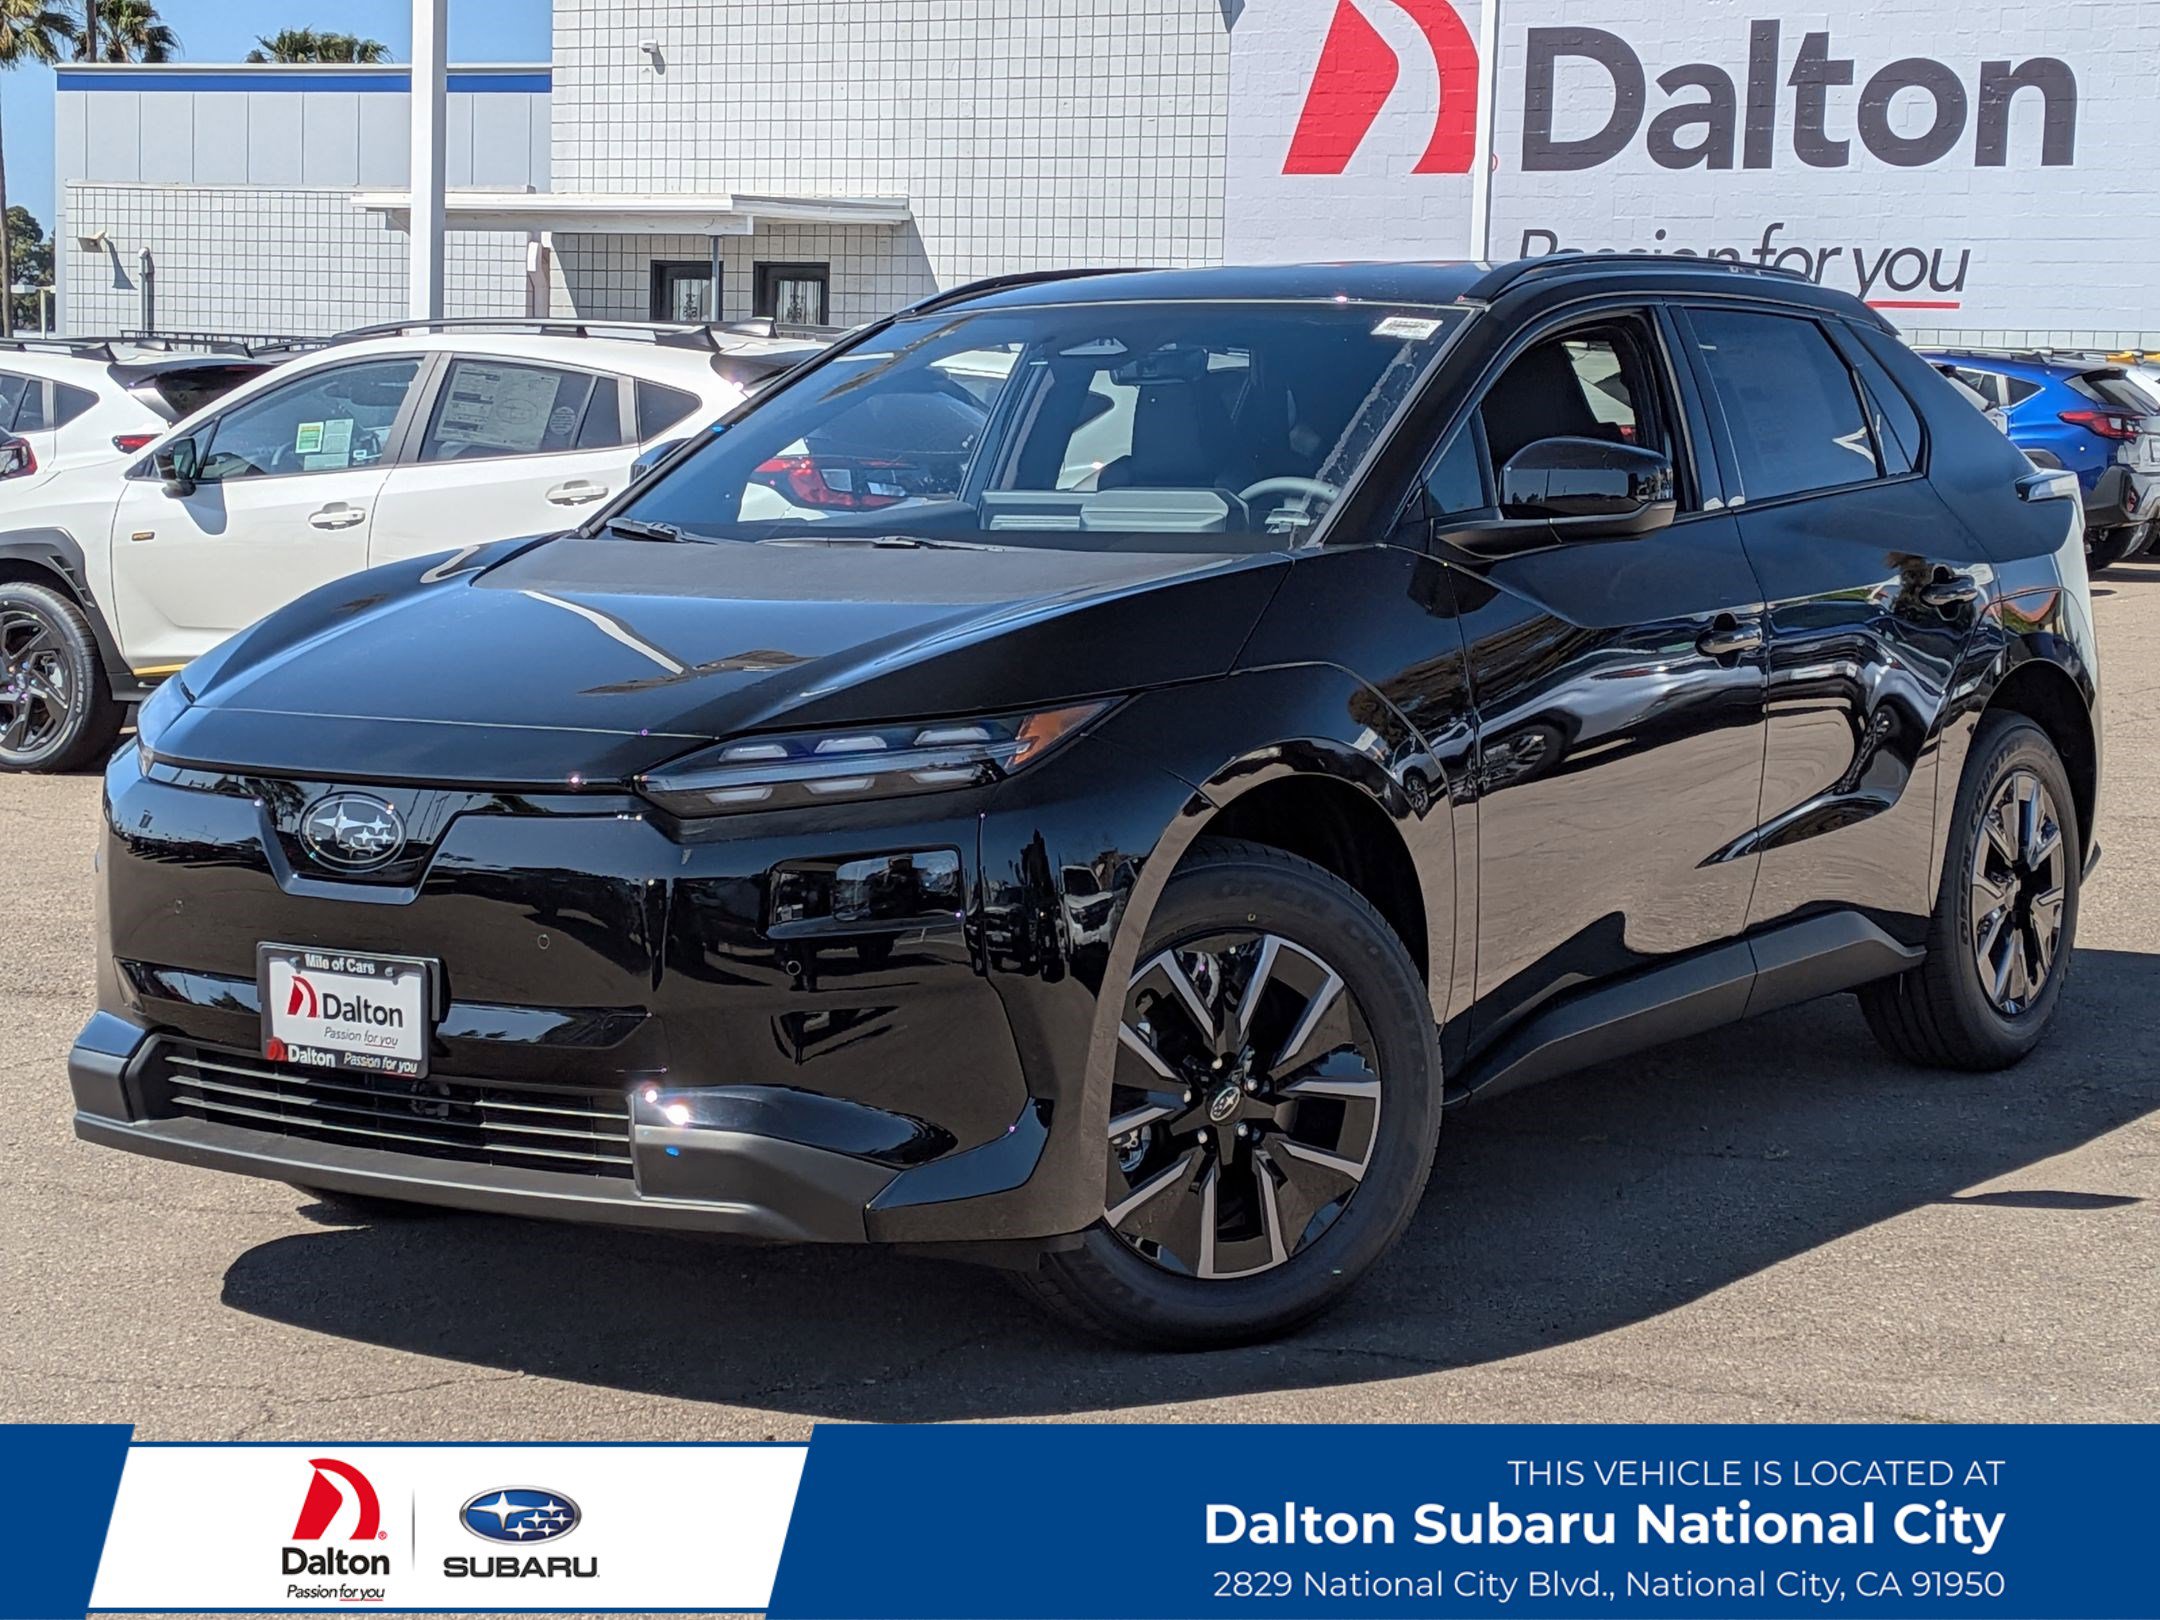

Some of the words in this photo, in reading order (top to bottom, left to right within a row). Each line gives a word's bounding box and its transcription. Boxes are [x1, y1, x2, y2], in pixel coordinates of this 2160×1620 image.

[1521, 19, 2078, 171] Dalton
[1853, 246, 1971, 299] you
[304, 953, 330, 970] Mile
[331, 957, 345, 972] of
[346, 958, 376, 975] Cars
[322, 992, 404, 1028] Dalton
[324, 1026, 361, 1042] Passion
[364, 1030, 379, 1044] for
[379, 1036, 399, 1047] you
[288, 1045, 336, 1068] Dalton
[344, 1052, 381, 1067] Passion
[382, 1056, 397, 1071] for
[399, 1061, 418, 1074] you
